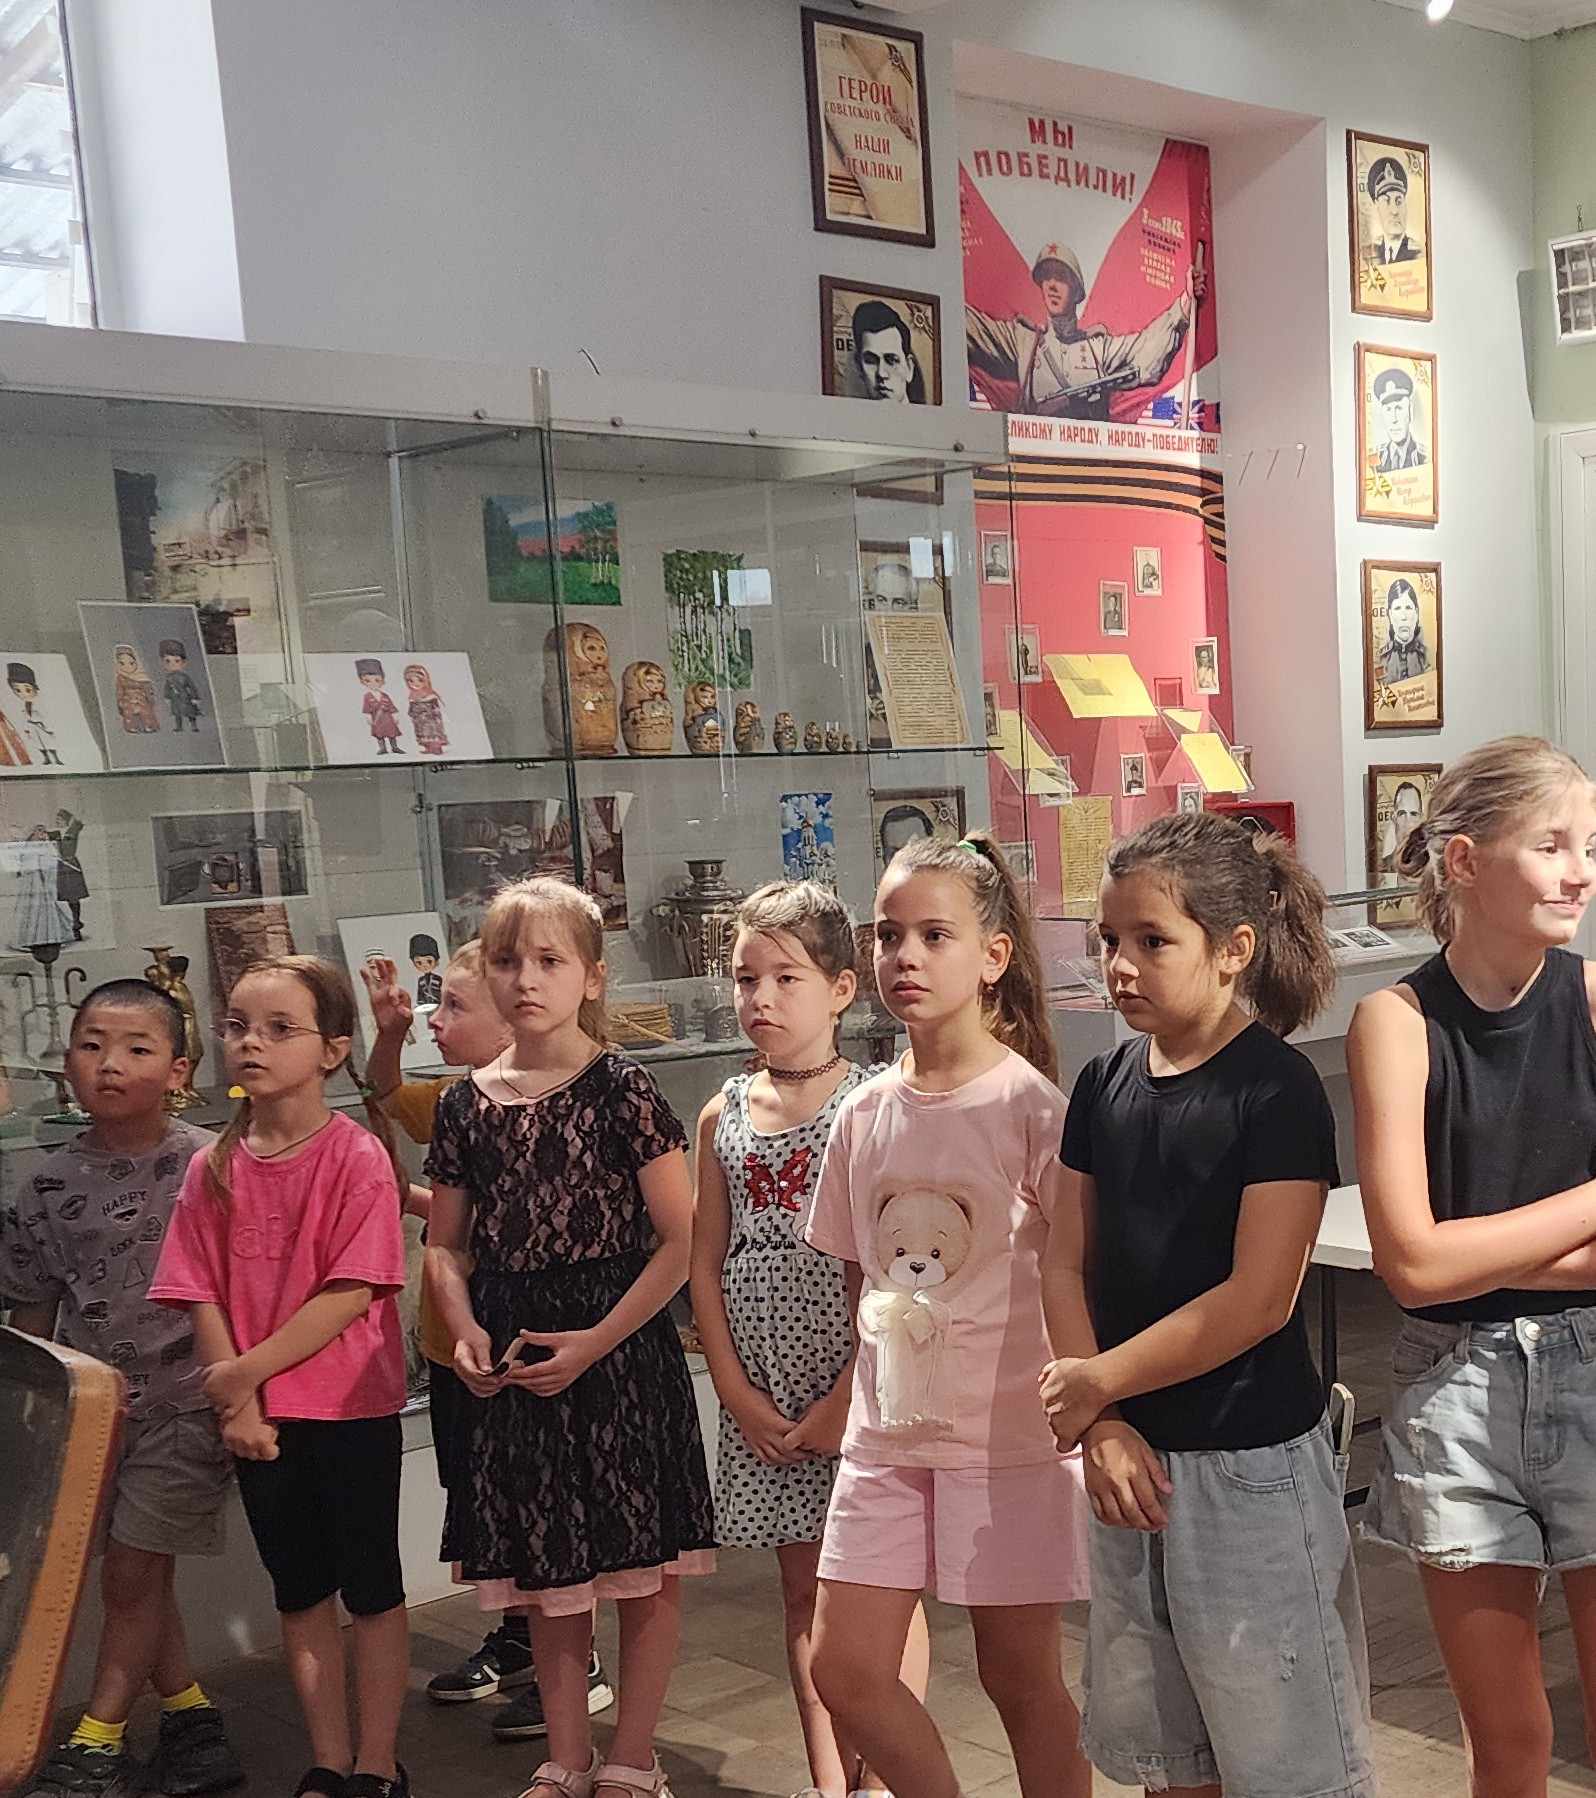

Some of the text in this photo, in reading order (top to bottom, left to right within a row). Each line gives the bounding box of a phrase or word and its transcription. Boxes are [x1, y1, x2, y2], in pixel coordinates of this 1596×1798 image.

[838, 75, 892, 107] ГЕРОИ
[825, 101, 881, 122] СОВЕТСКОГО
[854, 134, 891, 155] НАШИ
[1028, 117, 1074, 151] МЫ
[973, 150, 1136, 202] ПОБЕДИЛИ!
[1007, 419, 1219, 455] ЛИКОМУ НАРОДУ, НАРОДУ-ПОБЕДИТЕЛЮ!
[101, 1190, 148, 1216] HAPPY
